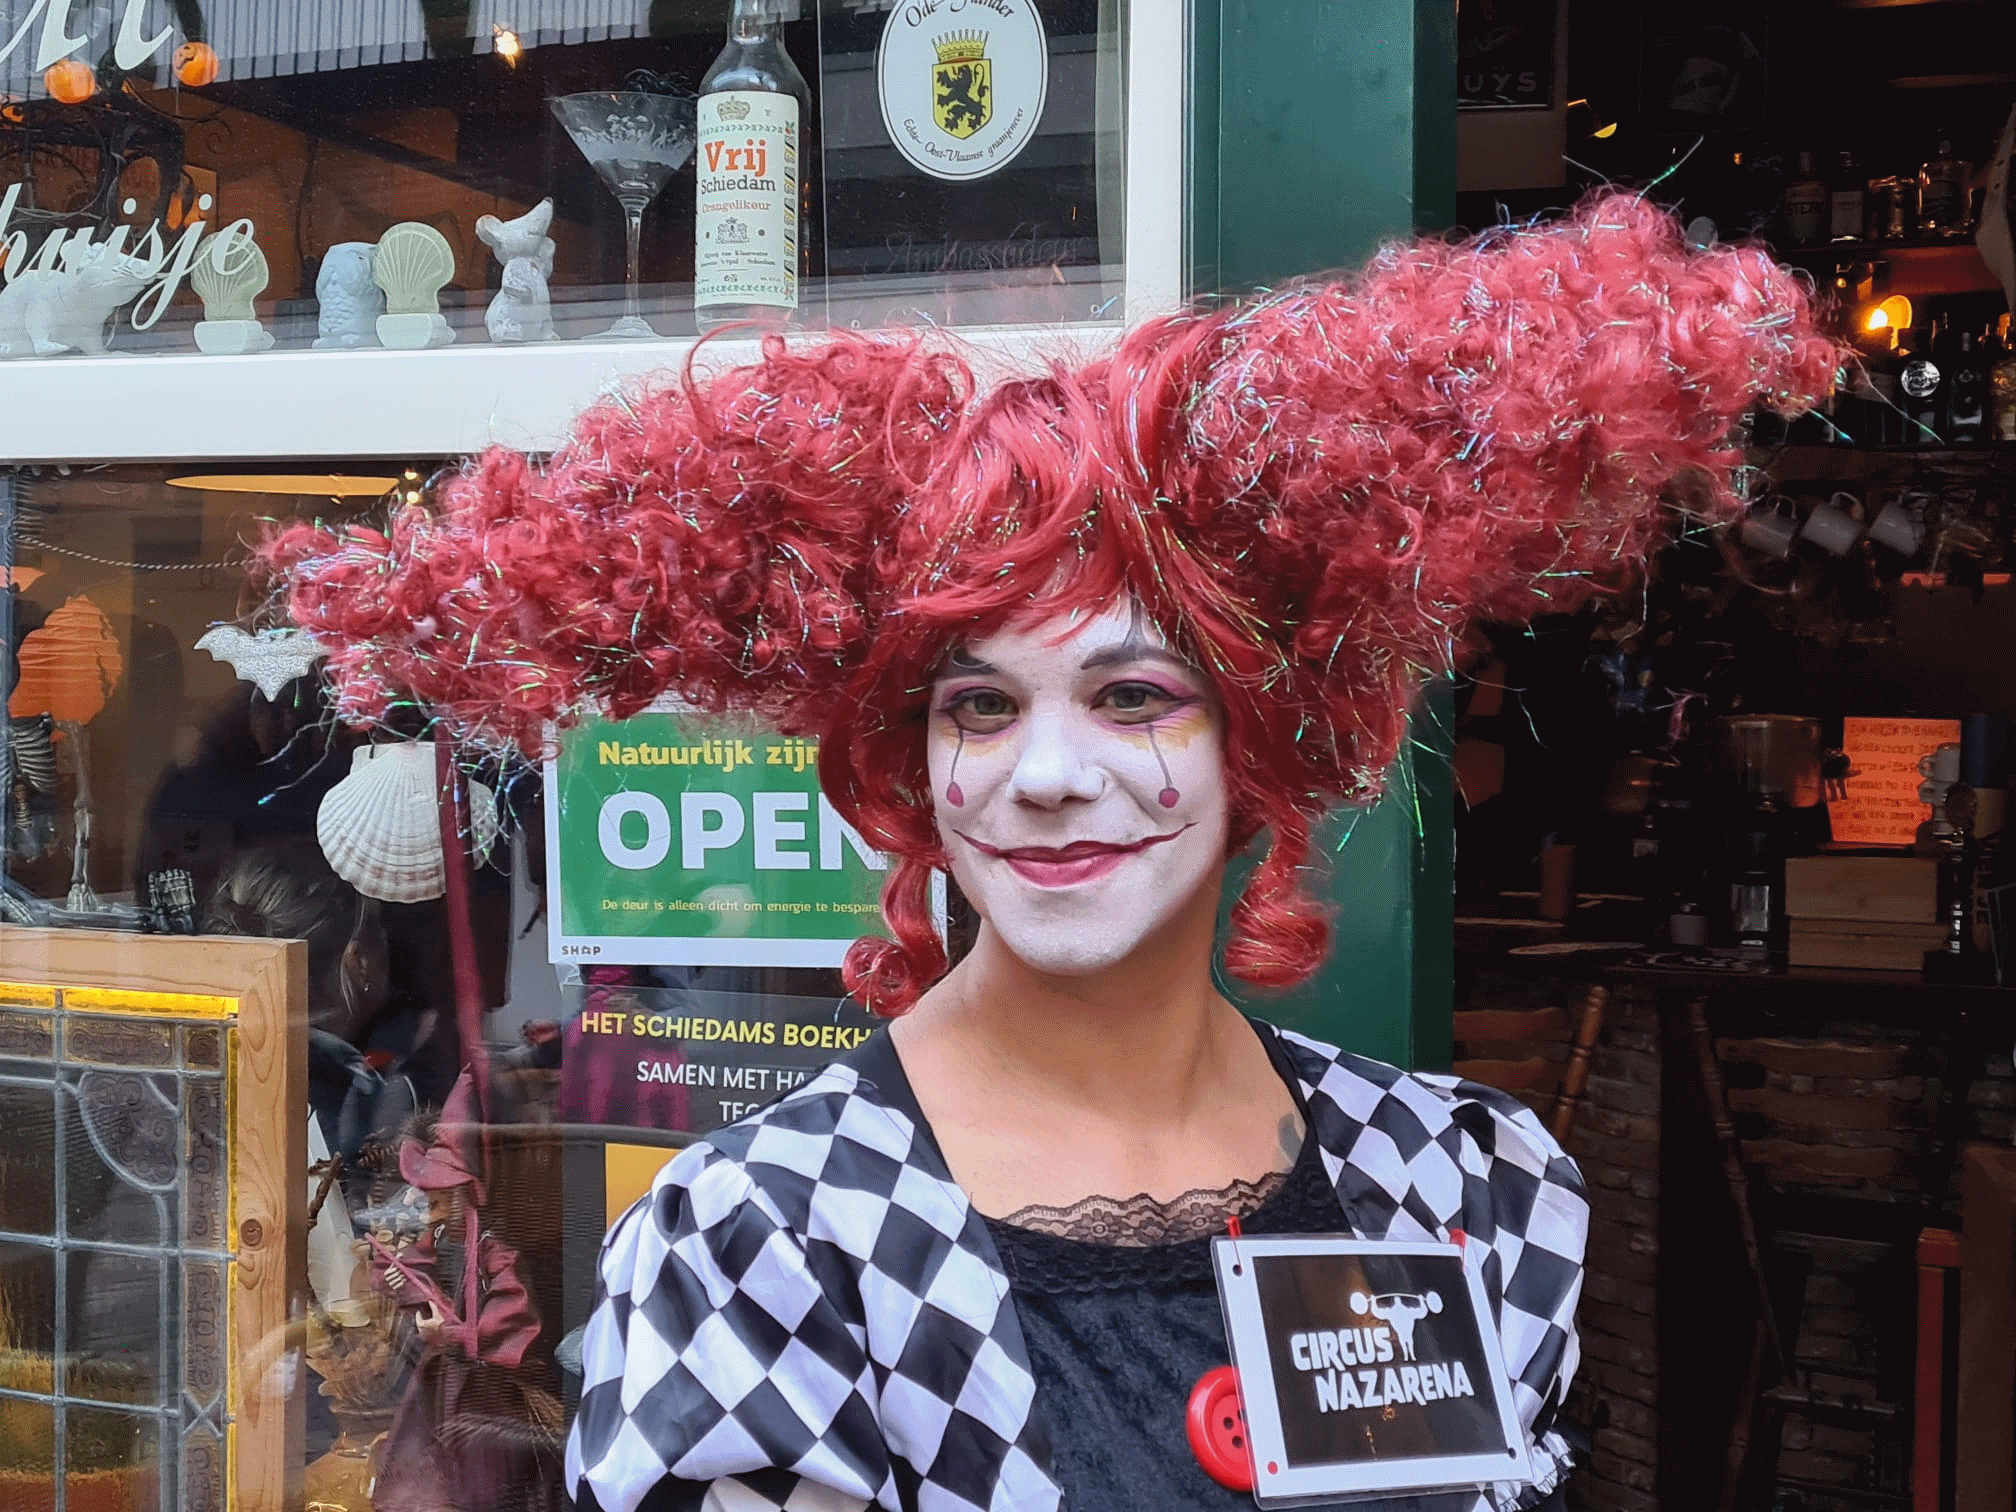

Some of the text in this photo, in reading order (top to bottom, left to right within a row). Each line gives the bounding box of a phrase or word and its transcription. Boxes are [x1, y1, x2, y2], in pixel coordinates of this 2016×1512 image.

[704, 138, 767, 178] Vrij
[701, 174, 776, 195] Schiedam
[598, 739, 754, 773] Natuurlijk
[597, 790, 890, 871] OPEN
[602, 899, 618, 911] De
[622, 899, 649, 911] deur
[654, 899, 664, 911] is
[668, 899, 704, 912] alleen
[708, 899, 740, 912] dicht
[743, 902, 763, 912] om
[766, 903, 812, 915] energie
[815, 902, 828, 912] te
[581, 1011, 627, 1035] HET
[632, 1014, 776, 1046] SCHIEDAMS
[636, 1060, 716, 1087] SAMEN
[722, 1066, 770, 1091] MET
[1290, 1327, 1394, 1372] CIRCUS
[1315, 1359, 1475, 1414] NAZARENA
